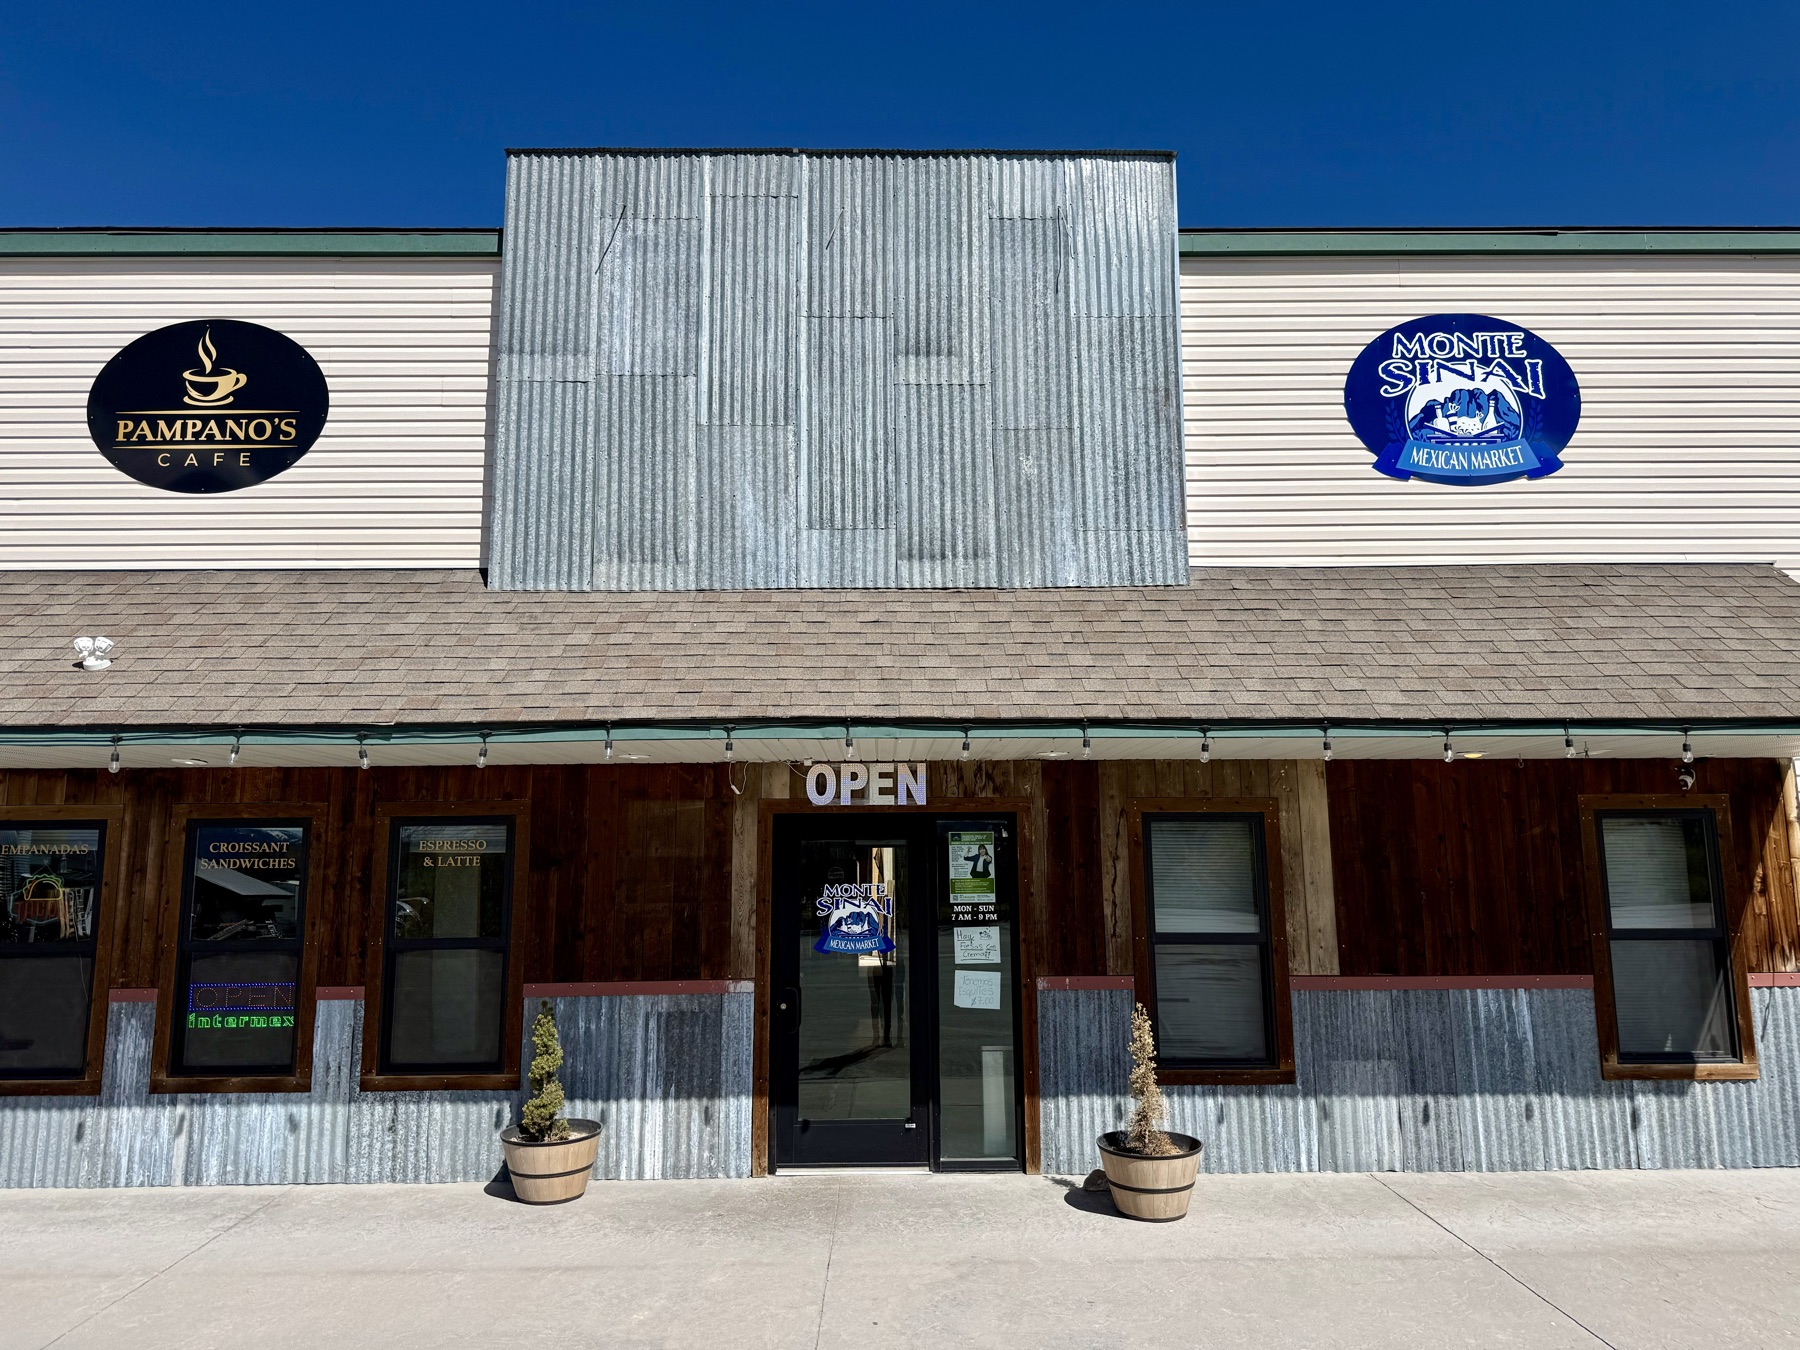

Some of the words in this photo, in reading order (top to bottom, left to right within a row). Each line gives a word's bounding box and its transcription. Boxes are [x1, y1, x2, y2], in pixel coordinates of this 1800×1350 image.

[1391, 331, 1527, 359] MONTE
[1378, 358, 1546, 400] SINAI
[115, 418, 297, 442] PAMPANO'S
[157, 452, 251, 467] CAFE
[1409, 446, 1469, 471] MEXICAN
[1471, 445, 1526, 470] MARKET
[805, 762, 927, 806] OPEN
[1, 843, 89, 855] EMPANADAS
[209, 841, 290, 853] CROISSANT
[418, 839, 487, 851] ESPRESSO
[200, 858, 296, 870] SANDWICHES
[423, 856, 434, 867] &
[437, 856, 481, 867] LATTE
[822, 883, 887, 897] MONTE
[816, 896, 894, 918] SINAI
[951, 913, 956, 921] 7
[957, 913, 972, 921] AM
[978, 913, 984, 921] 9
[985, 913, 998, 921] PM
[828, 939, 855, 950] MEXICAN
[856, 937, 880, 949] MARKET
[196, 985, 293, 1008] OPEN
[188, 1012, 295, 1029] intermex
